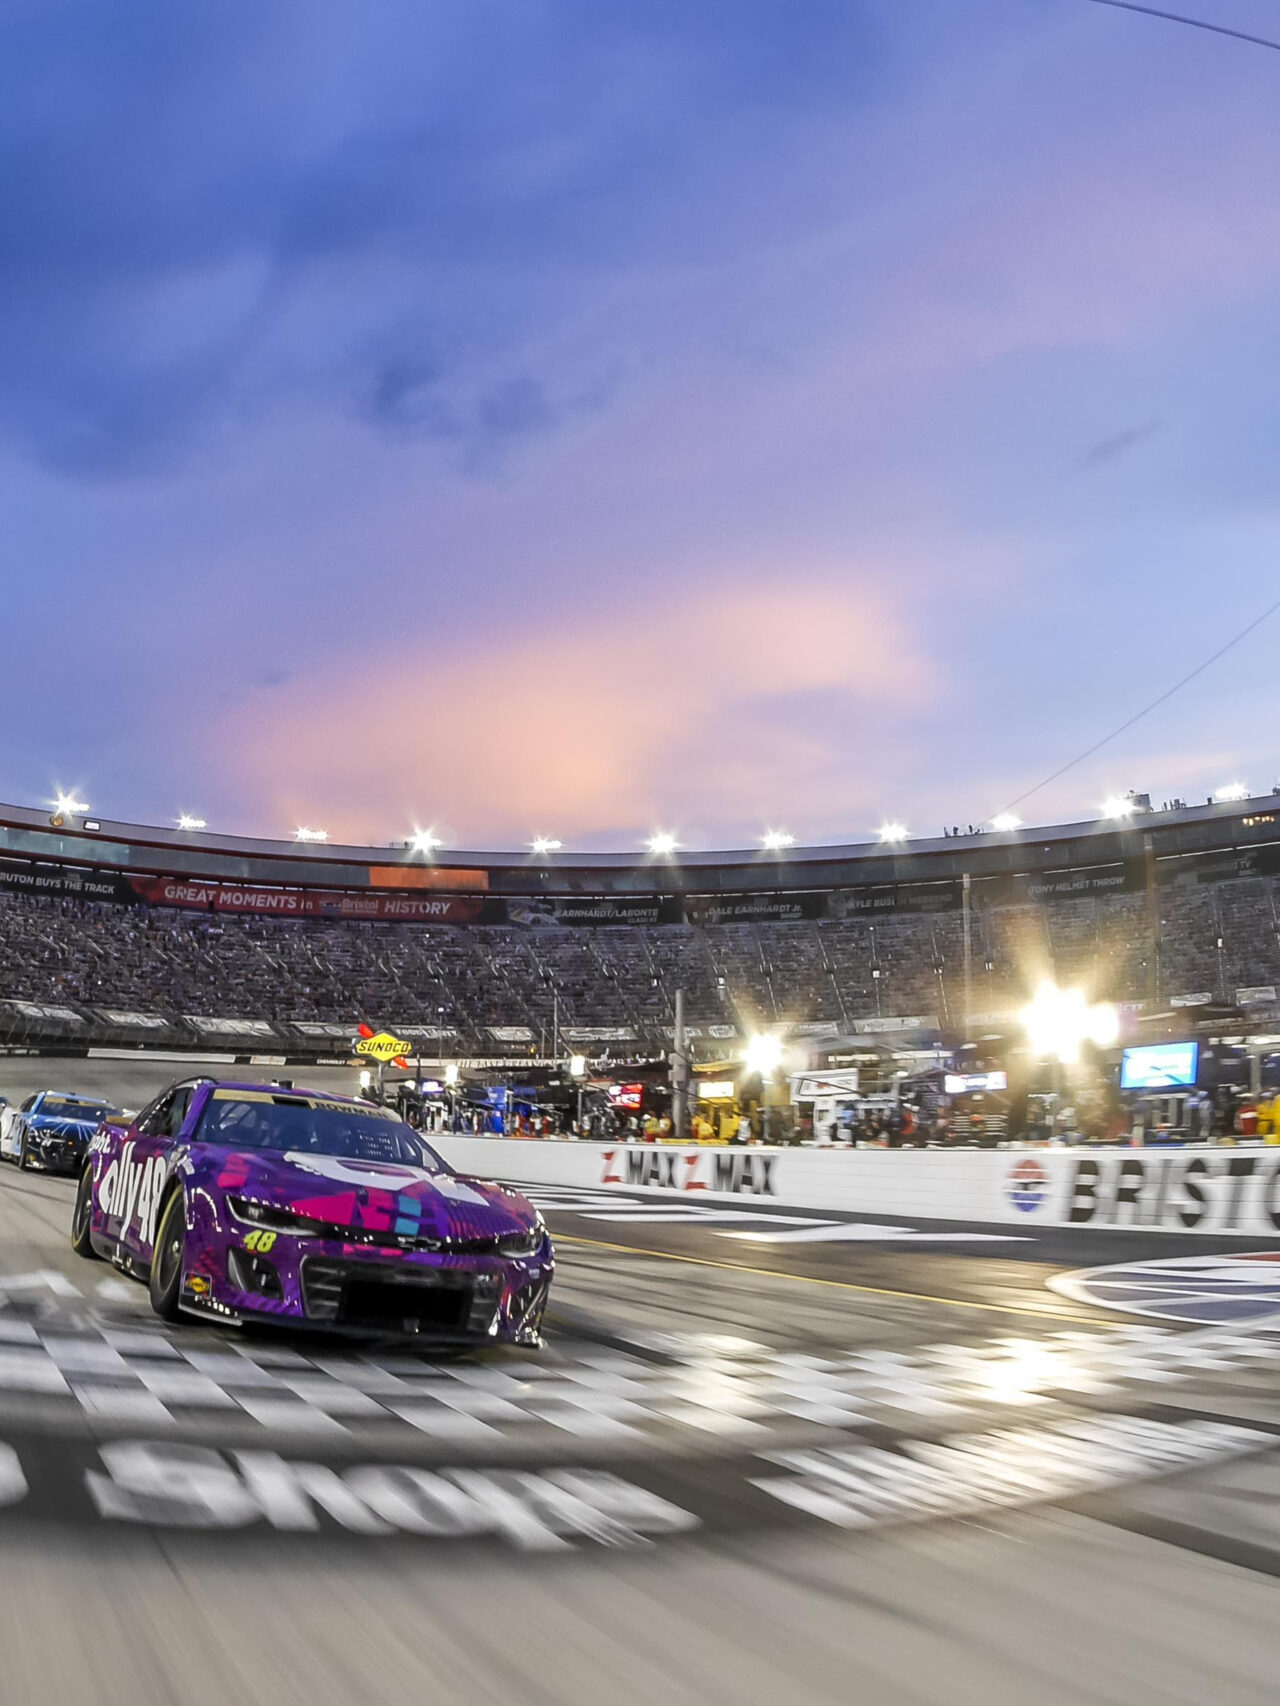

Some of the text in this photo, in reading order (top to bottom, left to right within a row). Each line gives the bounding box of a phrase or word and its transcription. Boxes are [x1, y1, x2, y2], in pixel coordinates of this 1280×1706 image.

[36, 877, 61, 889] BUYS
[64, 880, 82, 892] THE
[84, 882, 115, 894] TRACK
[1055, 880, 1090, 892] HELMET
[1092, 876, 1125, 888] THROW
[164, 885, 217, 903] GREAT
[219, 891, 297, 909] MOMENTS
[384, 901, 451, 915] HISTORY
[358, 1041, 410, 1053] SUNOCO
[1068, 1156, 1280, 1229] BRIST
[244, 1229, 277, 1253] 48
